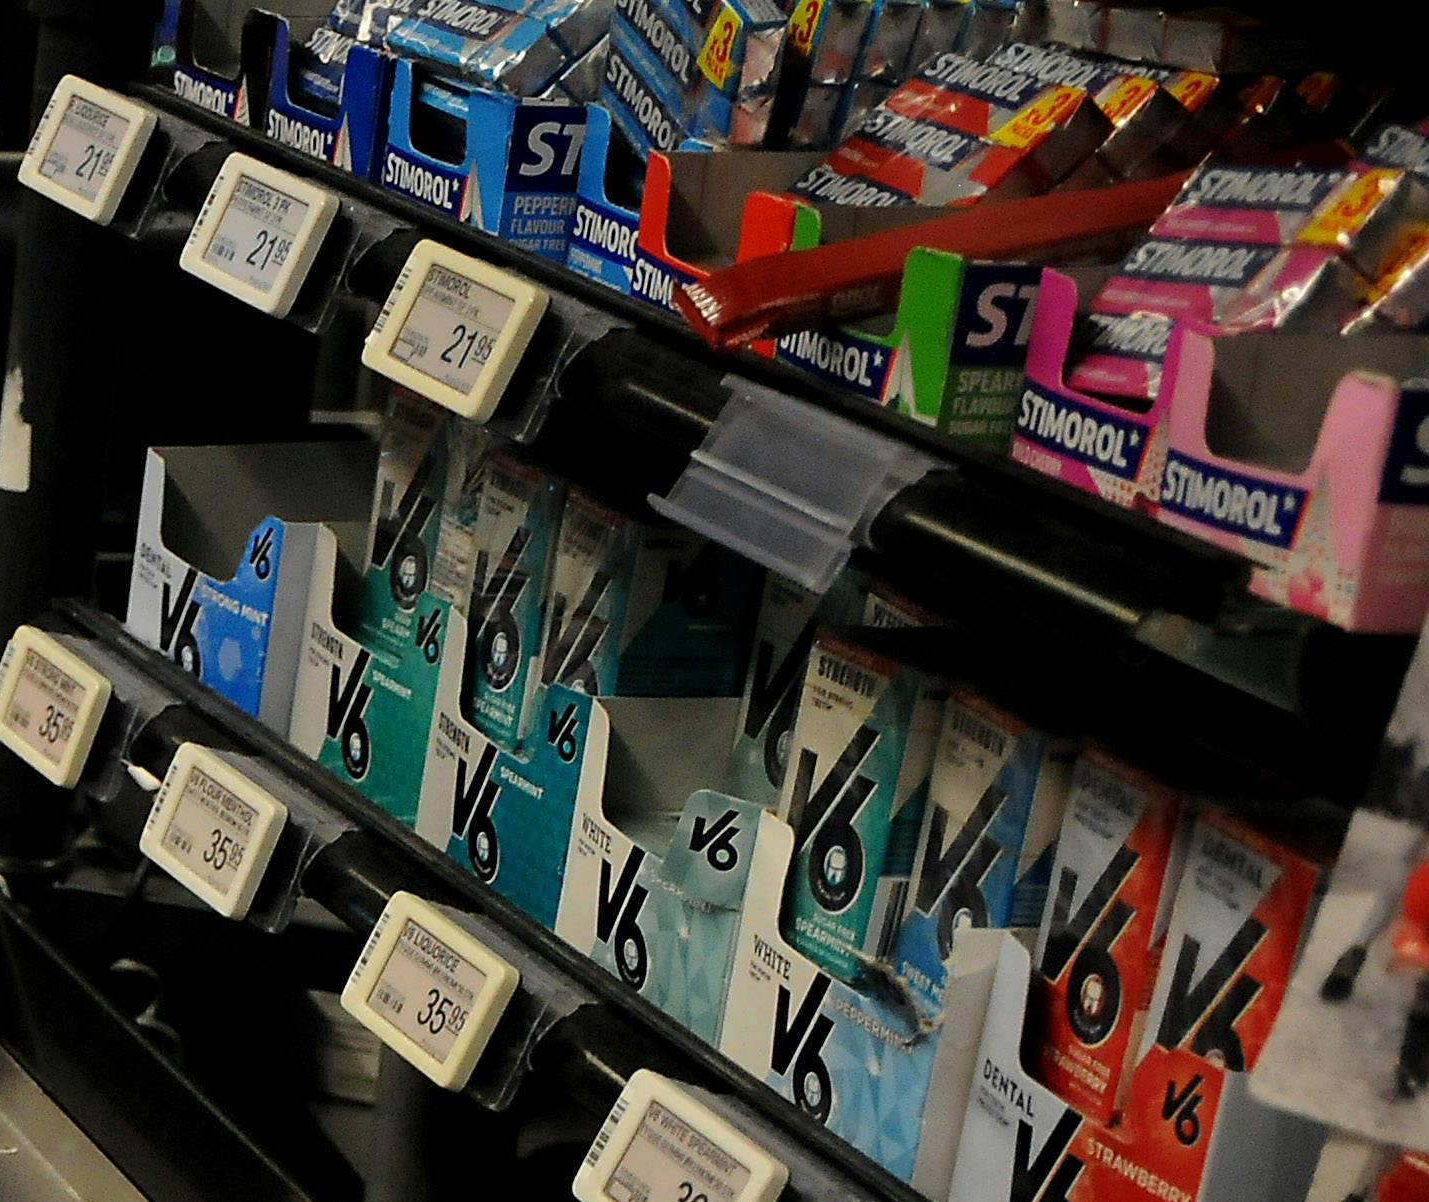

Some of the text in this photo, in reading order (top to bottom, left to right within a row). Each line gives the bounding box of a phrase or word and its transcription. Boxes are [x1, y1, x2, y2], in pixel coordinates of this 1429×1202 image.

[174, 70, 229, 117] STIMOROL
[924, 51, 1031, 102] STIMOROL
[267, 108, 328, 161] STIMOROL
[864, 110, 970, 163] STIMOROL
[385, 152, 453, 210] STIMOROL
[510, 218, 566, 234] FLAVOUR
[572, 204, 640, 261] STIMORO
[1017, 388, 1128, 469] STIMOROL
[1163, 460, 1281, 538] STIMOROL
[249, 527, 275, 580] V6
[160, 566, 203, 680] V6
[415, 608, 441, 665] V6
[327, 647, 375, 781] V6
[548, 703, 580, 764] V6
[452, 742, 502, 884] V6
[582, 812, 613, 854] WHITE
[689, 808, 742, 872] V6
[785, 722, 882, 914] V6
[597, 844, 651, 992] V6
[1041, 843, 1142, 1049] V6
[413, 930, 461, 974] LIQUORICE
[753, 933, 792, 981] WHITE
[416, 988, 454, 1035] 35
[771, 971, 836, 1127] V6
[983, 1058, 1034, 1118] DENTAL
[1161, 1073, 1205, 1148] V6
